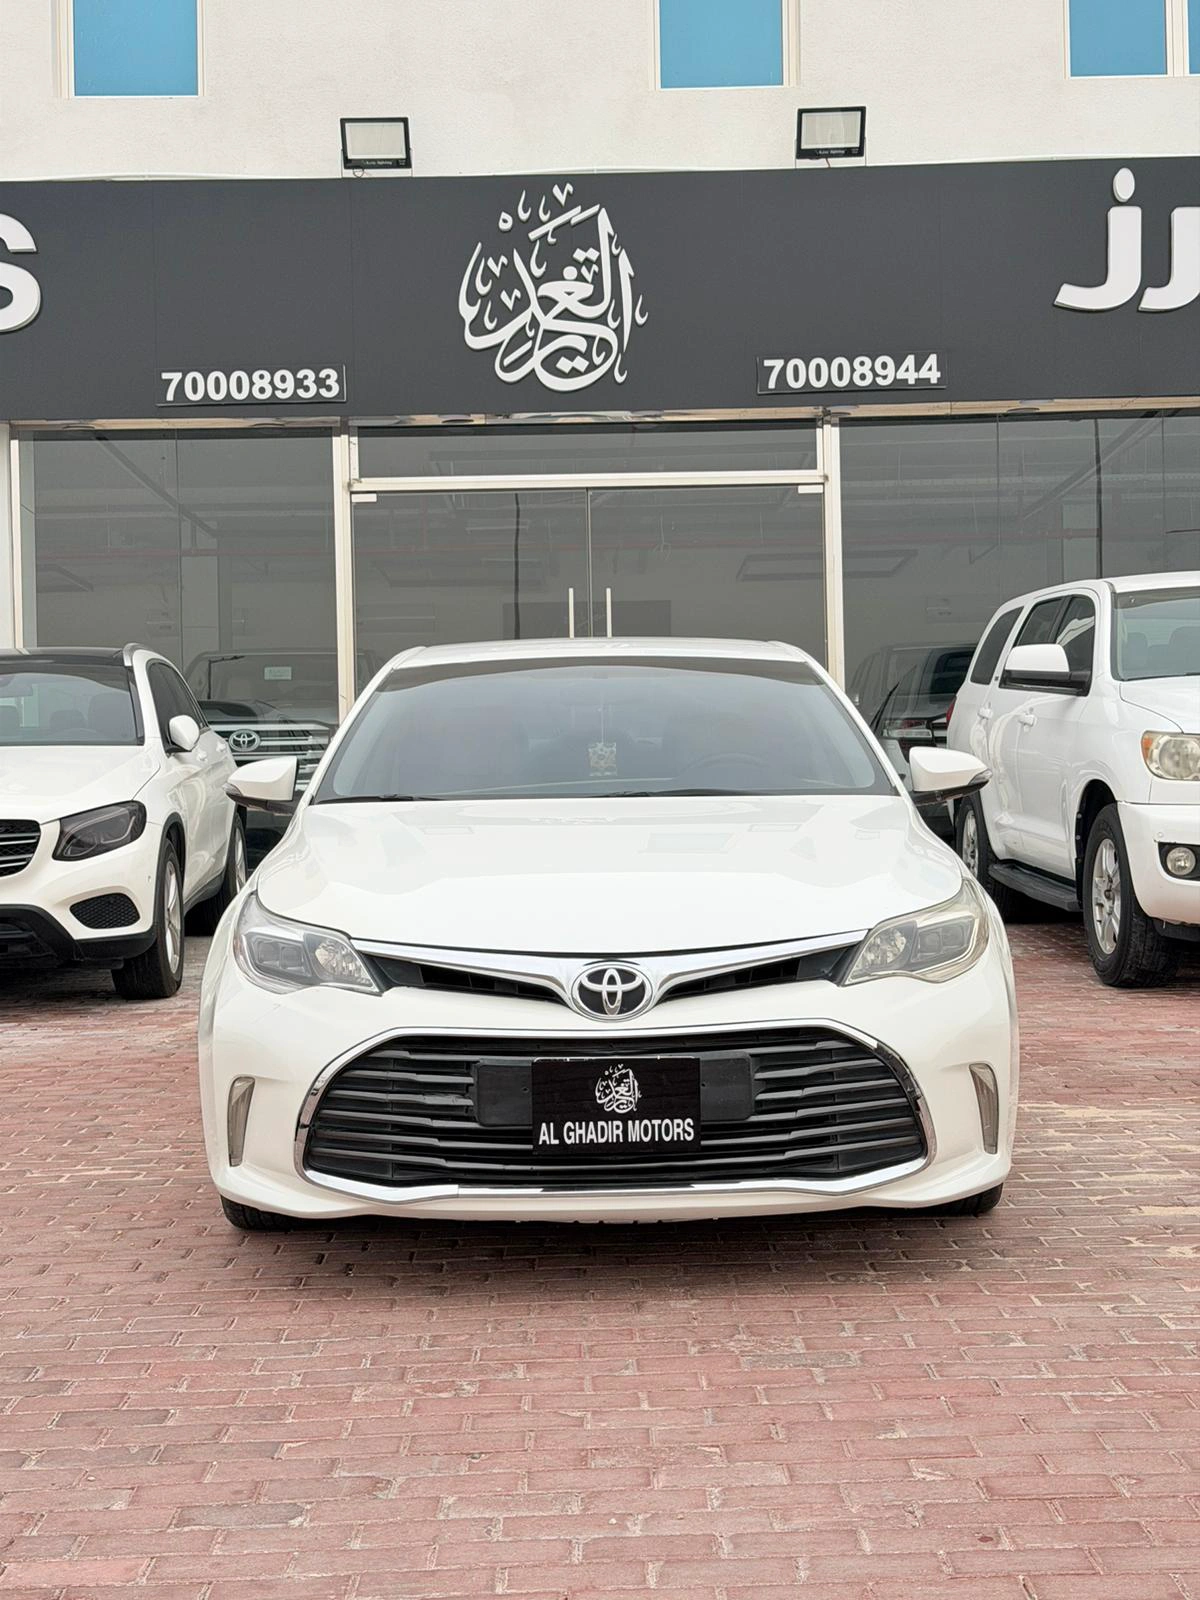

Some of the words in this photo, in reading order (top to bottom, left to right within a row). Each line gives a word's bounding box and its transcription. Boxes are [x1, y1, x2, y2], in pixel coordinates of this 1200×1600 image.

[161, 368, 340, 402] 70008933
[763, 353, 941, 389] 70008944
[538, 1122, 560, 1145] AL
[563, 1120, 624, 1145] GHADIR
[627, 1117, 695, 1143] MOTORS
